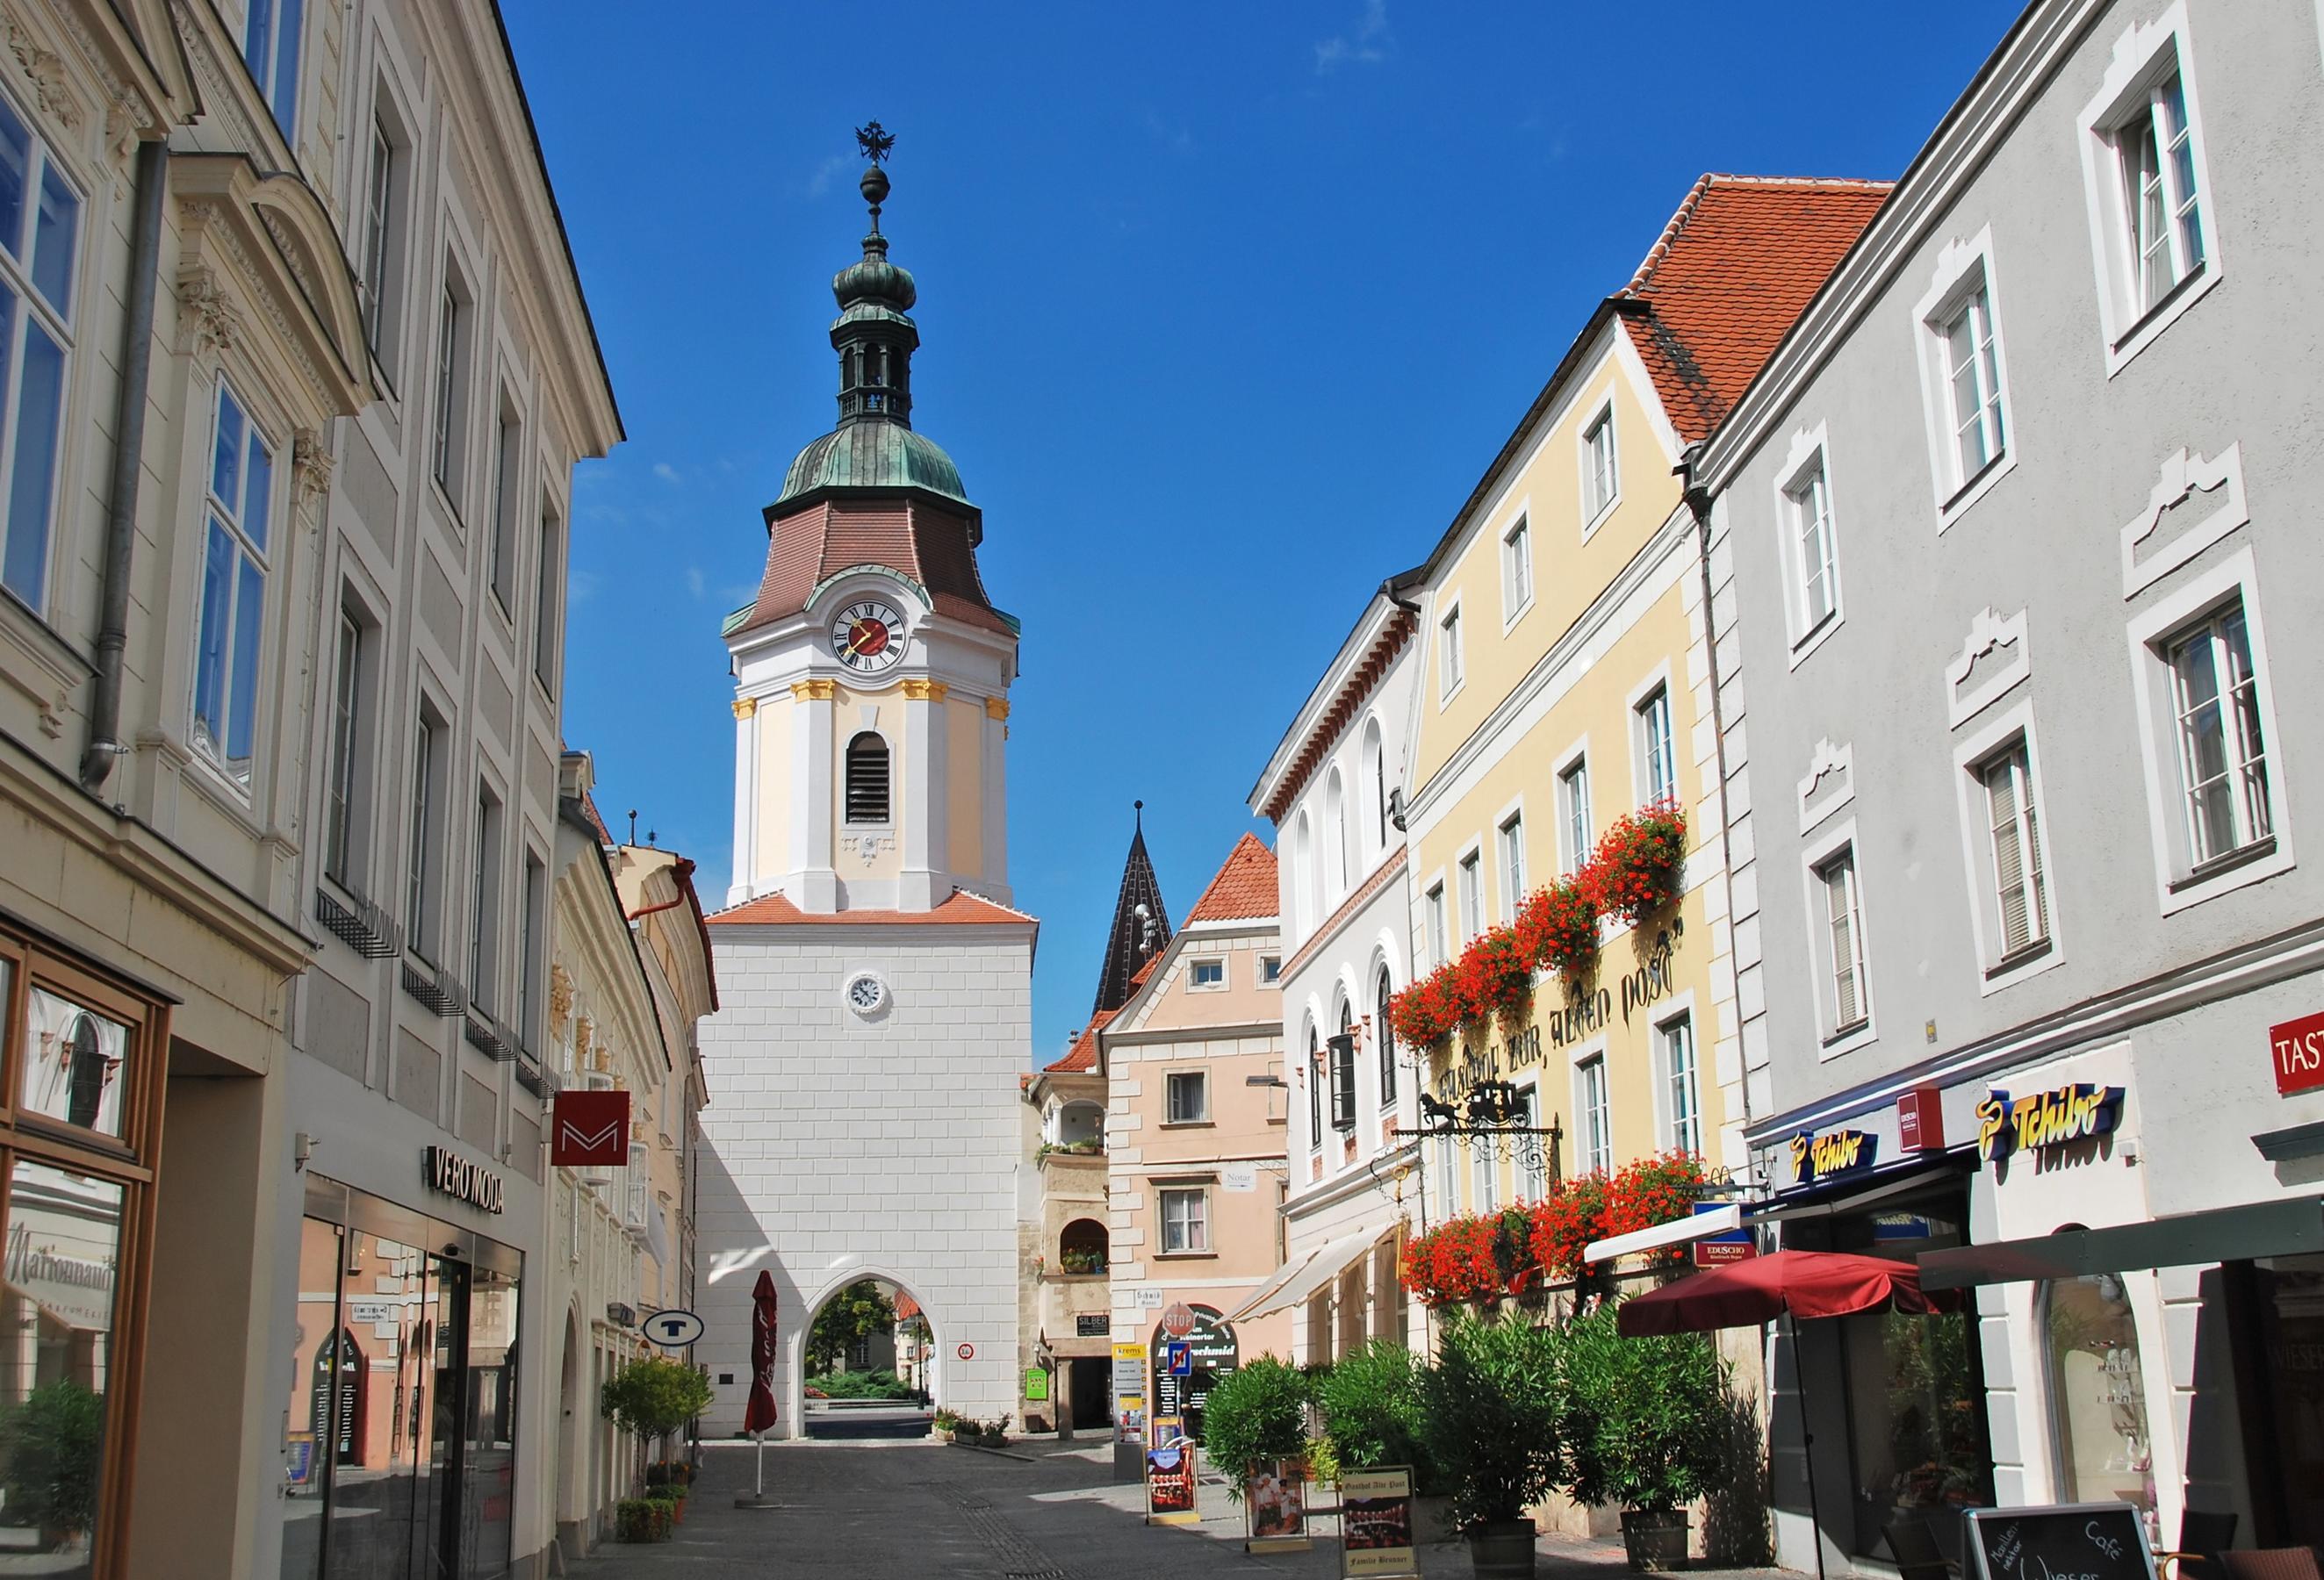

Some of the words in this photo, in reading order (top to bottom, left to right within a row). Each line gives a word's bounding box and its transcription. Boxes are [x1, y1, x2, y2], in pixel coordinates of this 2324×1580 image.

[2012, 1084, 2106, 1149] Tchibo
[1811, 1131, 1862, 1176] Tchibo
[435, 1146, 470, 1199] VERO
[471, 1166, 504, 1215] MODA
[1079, 1316, 1108, 1325] SILBER
[1166, 1314, 1192, 1326] STOP
[1345, 1482, 1371, 1491] Gasthof
[1389, 1480, 1406, 1490] Post
[2085, 1520, 2123, 1561] Café
[1349, 1558, 1376, 1568] Familie
